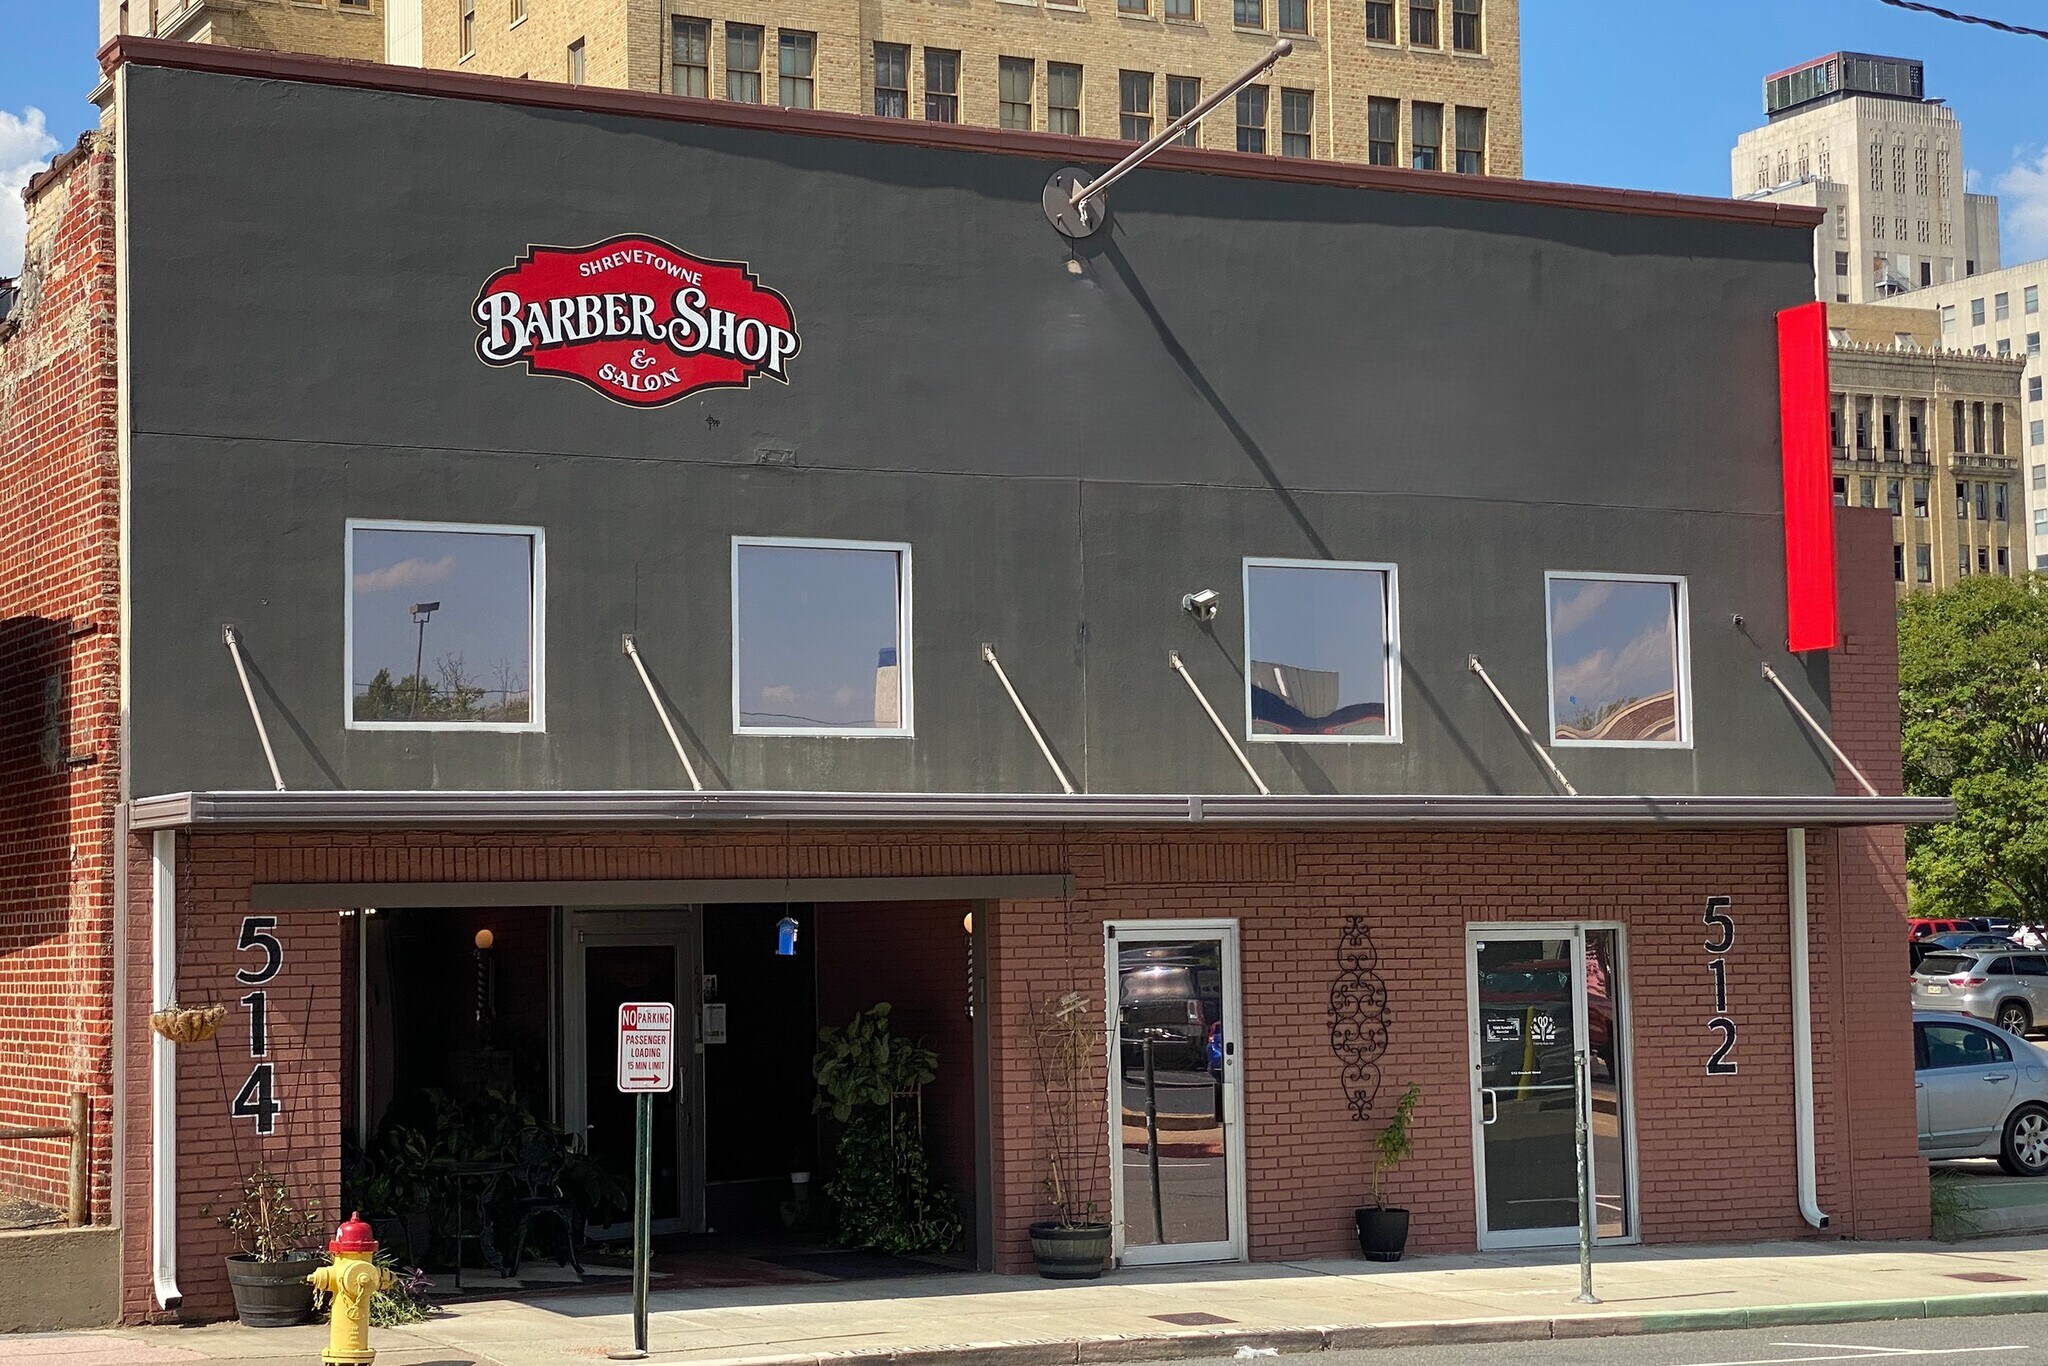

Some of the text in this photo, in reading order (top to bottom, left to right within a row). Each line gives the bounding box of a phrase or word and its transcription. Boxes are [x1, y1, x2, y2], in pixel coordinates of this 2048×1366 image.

[579, 249, 702, 286] SHREVETOWNE
[477, 287, 797, 372] BARBER SHOP
[630, 348, 656, 370] &
[598, 363, 681, 392] SALON
[1703, 896, 1738, 1075] 512
[232, 916, 283, 1135] 514
[622, 1010, 669, 1026] NO PARKING
[626, 1035, 666, 1045] PASSENGER
[631, 1048, 660, 1058] LOADING
[628, 1062, 665, 1070] 15 MIN LIMIT
